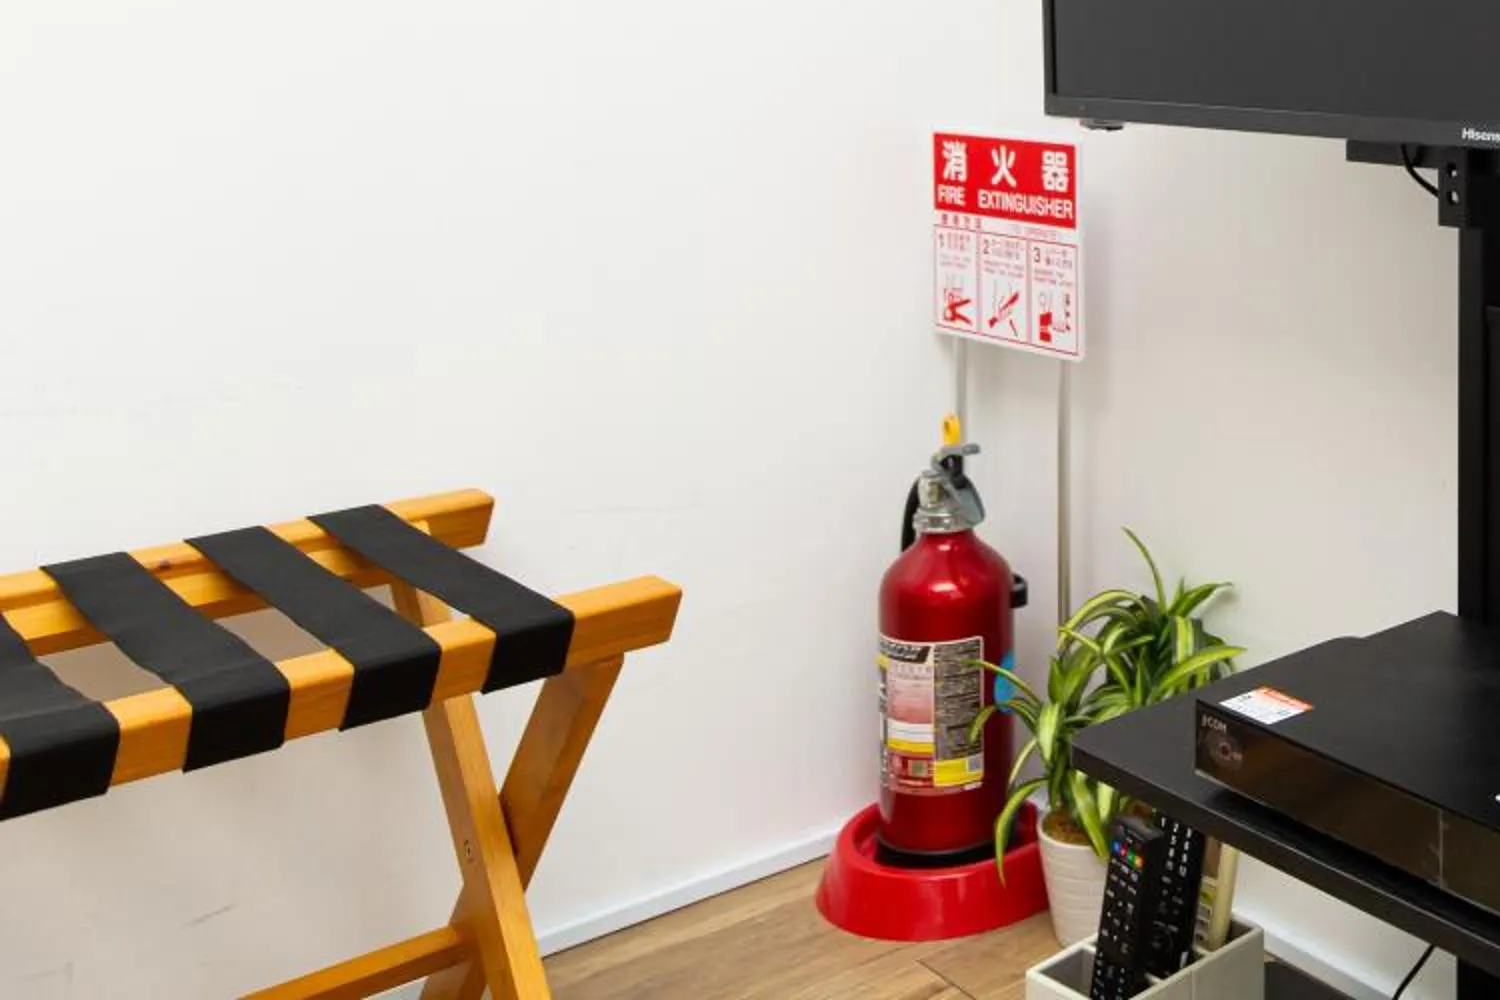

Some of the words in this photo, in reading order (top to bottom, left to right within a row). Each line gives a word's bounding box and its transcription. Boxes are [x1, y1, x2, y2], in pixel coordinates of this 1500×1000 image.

[942, 140, 1069, 192] 消火器
[937, 184, 966, 206] FIRE
[977, 189, 1073, 219] EXTINGUISHER
[1033, 246, 1041, 263] 3
